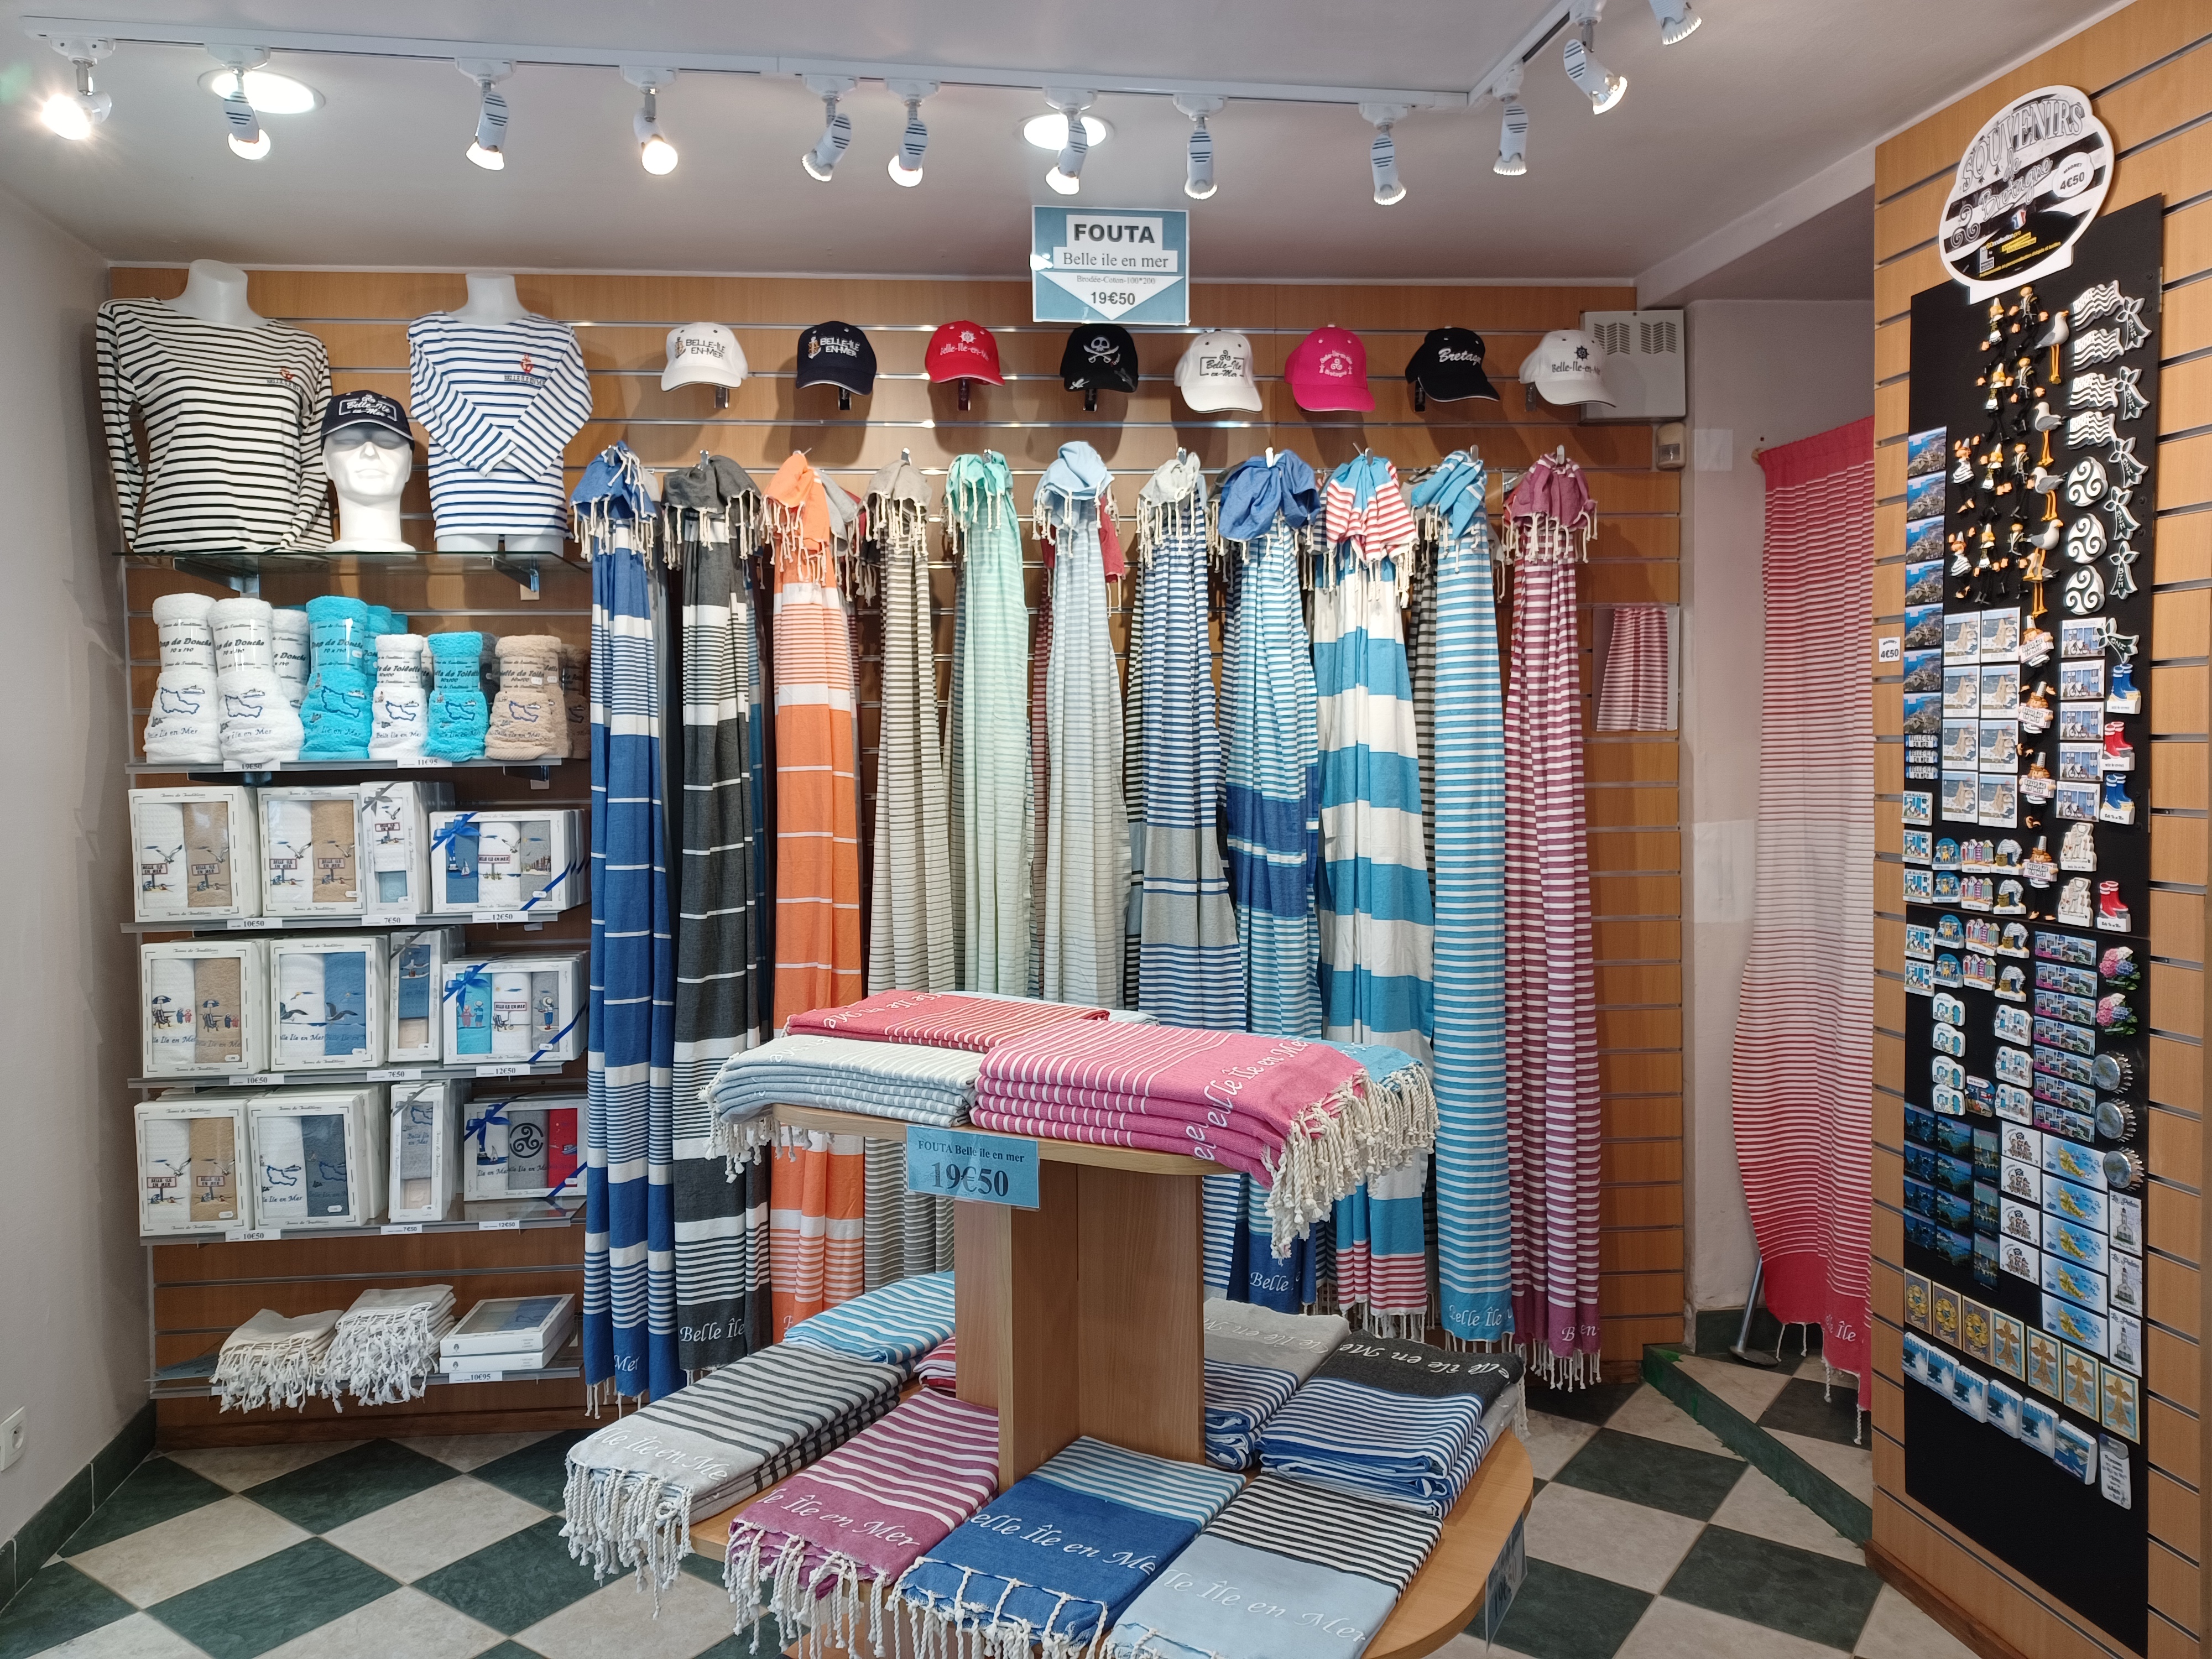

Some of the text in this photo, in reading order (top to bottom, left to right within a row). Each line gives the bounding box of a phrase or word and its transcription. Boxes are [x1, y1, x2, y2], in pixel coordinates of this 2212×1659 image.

[1962, 99, 2086, 192] SOUVENIRS
[2003, 148, 2020, 181] de
[1981, 158, 2053, 221] Bretagne
[2060, 172, 2085, 190] 4€50
[1074, 224, 1155, 243] FOUTA
[1063, 252, 1168, 268] Belle ile en mer
[1091, 292, 1135, 305] 19€50
[2127, 319, 2137, 338] BZH
[691, 347, 723, 358] EN-MER
[826, 346, 857, 358] EN-MER
[2125, 390, 2135, 409] BZH
[2122, 458, 2133, 476] BZH
[2116, 510, 2126, 530] BZH
[183, 638, 211, 646] Douche
[337, 639, 363, 649] Douche
[280, 652, 306, 661] Douche
[1880, 649, 1899, 659] 4€50
[255, 727, 272, 735] Mer
[824, 1011, 863, 1029] Me
[1204, 1037, 1312, 1128] elle Île en Me
[918, 1140, 953, 1154] FOUTA
[954, 1145, 977, 1156] Belle
[979, 1148, 990, 1158] ile
[1006, 1154, 1025, 1162] mer
[931, 1161, 1009, 1197] 19€50
[288, 1194, 303, 1202] Mer
[1250, 1272, 1289, 1291] Belle
[1484, 1306, 1503, 1327] Île
[680, 1317, 745, 1342] Belle Île
[1231, 1324, 1259, 1338] en
[1835, 1320, 1856, 1343] Île
[1338, 1343, 1385, 1358] Me
[1392, 1352, 1422, 1364] en
[1468, 1363, 1510, 1379] elle
[623, 1433, 665, 1456] Île
[653, 1444, 682, 1465] en
[682, 1449, 729, 1481] Me
[780, 1494, 921, 1548] Île en Mer
[970, 1511, 1156, 1577] elle Île en Me
[1196, 1579, 1241, 1606] Île
[1246, 1601, 1286, 1618] en
[1293, 1611, 1366, 1644] Mer
